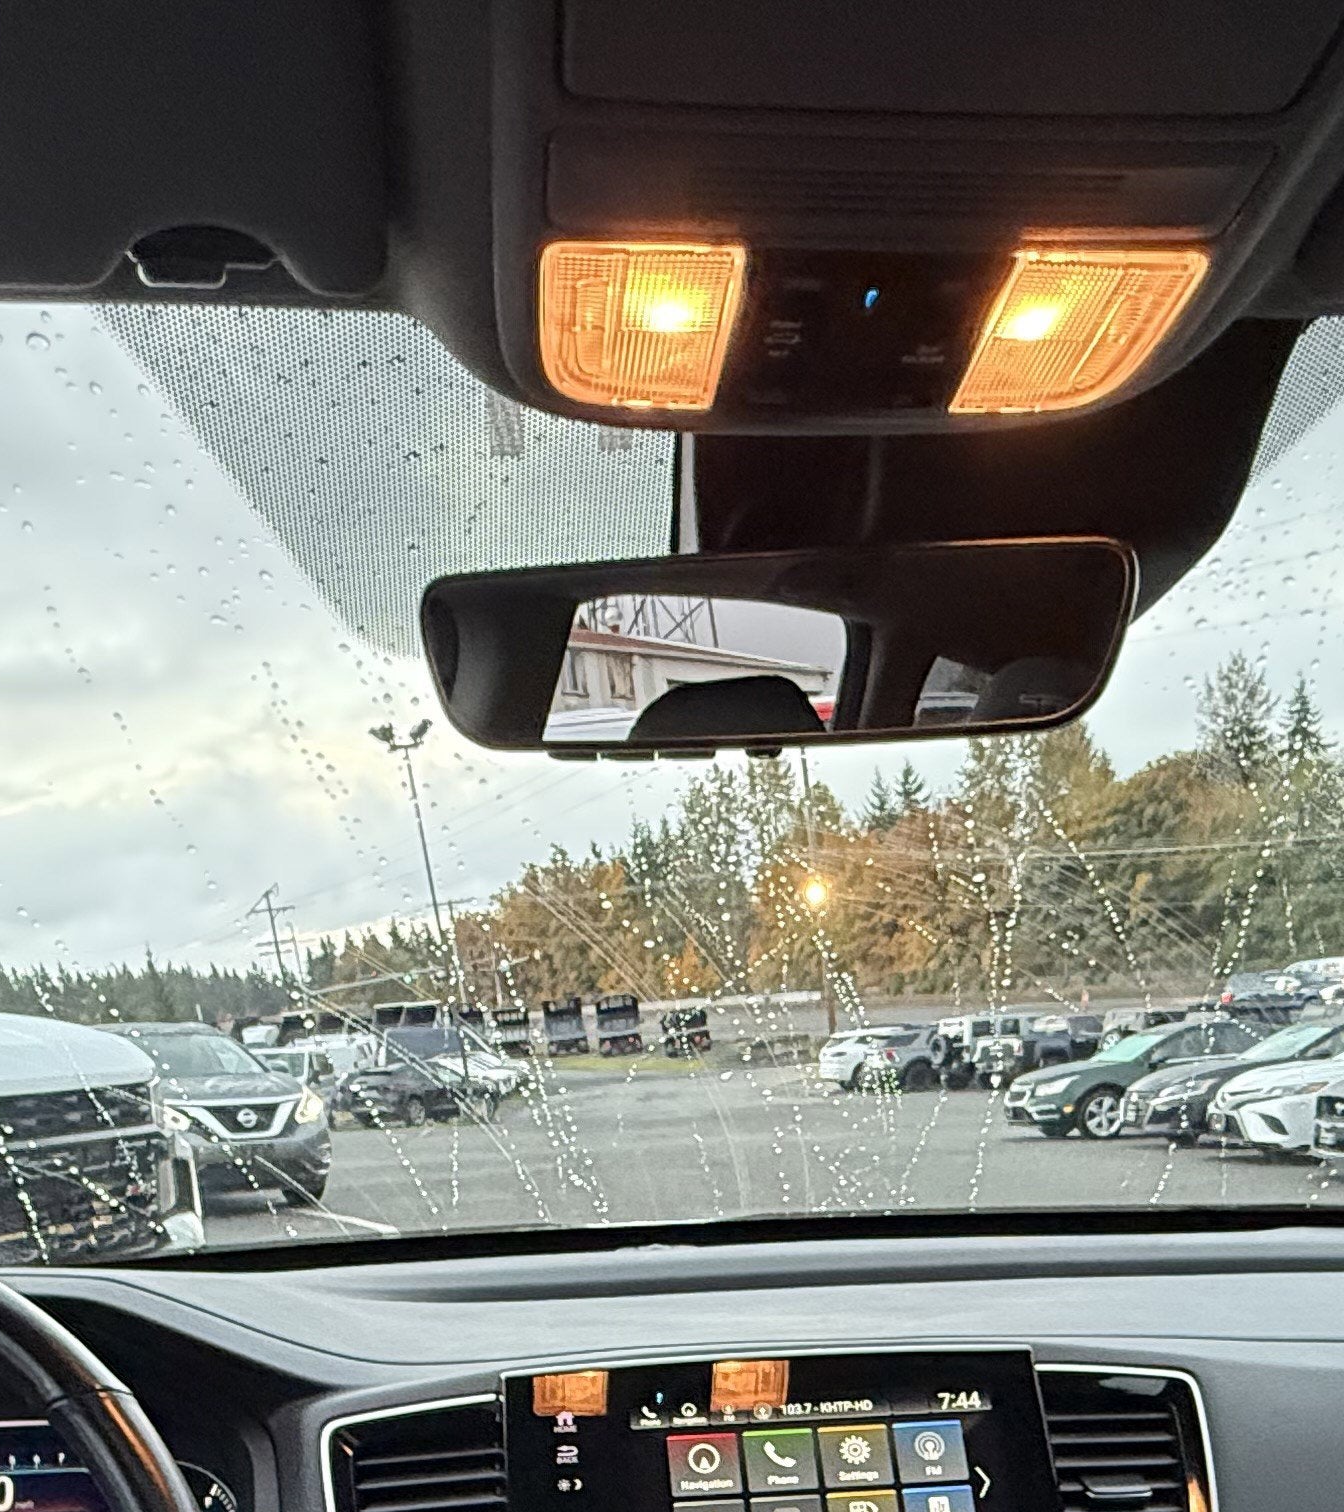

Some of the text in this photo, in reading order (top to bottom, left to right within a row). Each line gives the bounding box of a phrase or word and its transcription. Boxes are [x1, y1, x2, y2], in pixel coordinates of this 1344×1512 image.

[938, 1391, 981, 1410] 7:44
[781, 1403, 811, 1415] 103.7
[680, 1479, 734, 1492] Navigation
